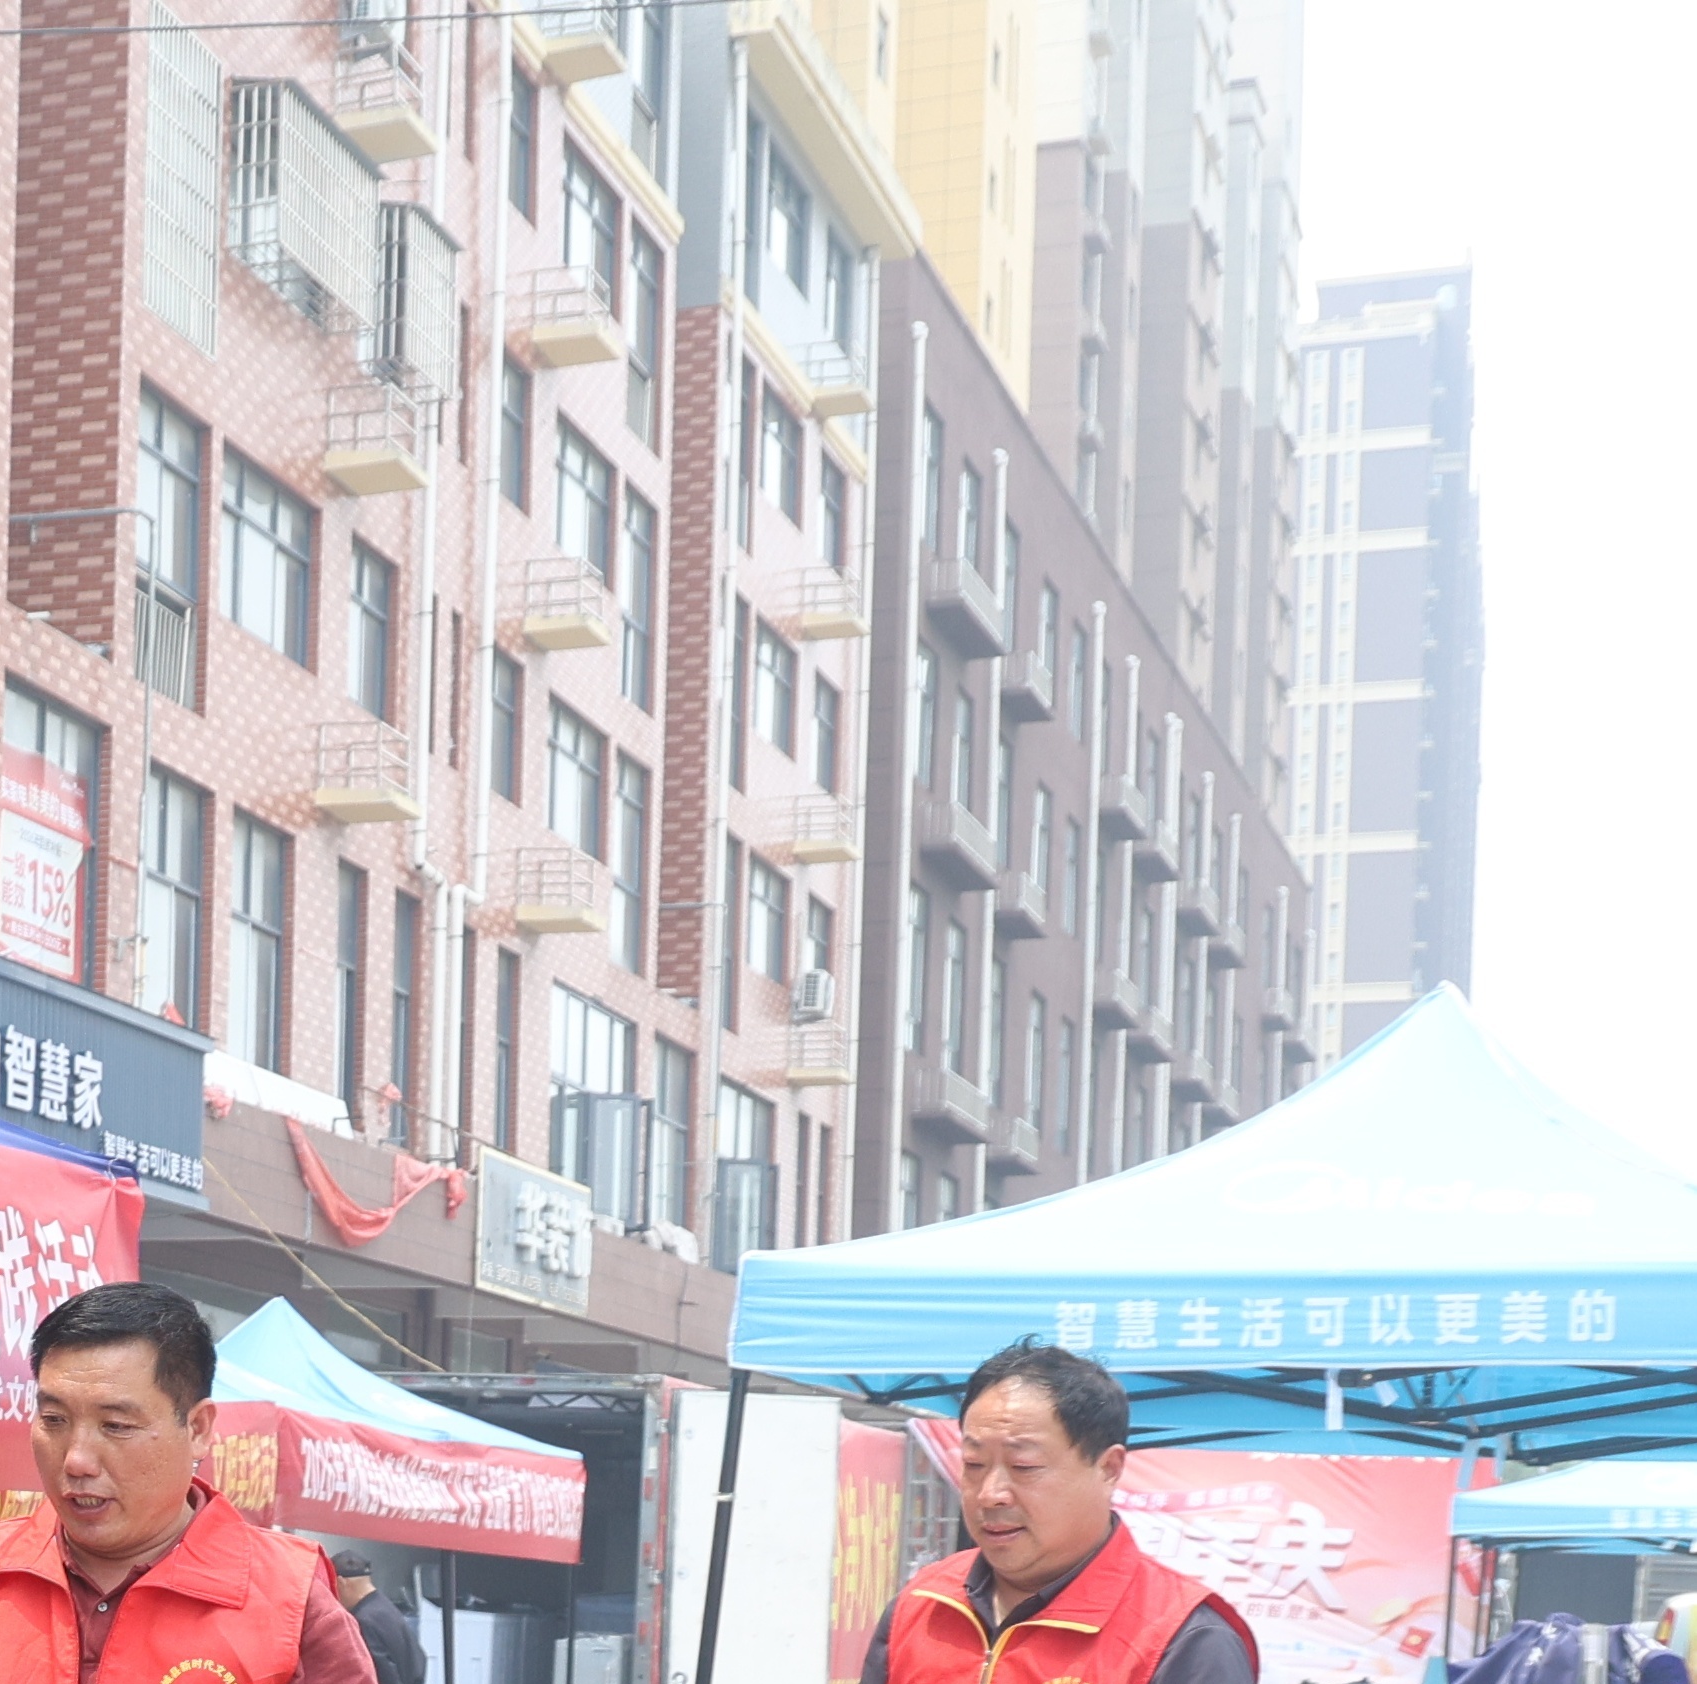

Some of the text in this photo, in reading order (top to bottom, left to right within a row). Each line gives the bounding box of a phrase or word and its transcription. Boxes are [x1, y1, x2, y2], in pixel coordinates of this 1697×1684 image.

[27, 857, 72, 929] 15%
[1054, 1288, 1617, 1351] 智慧生活可以更美的
